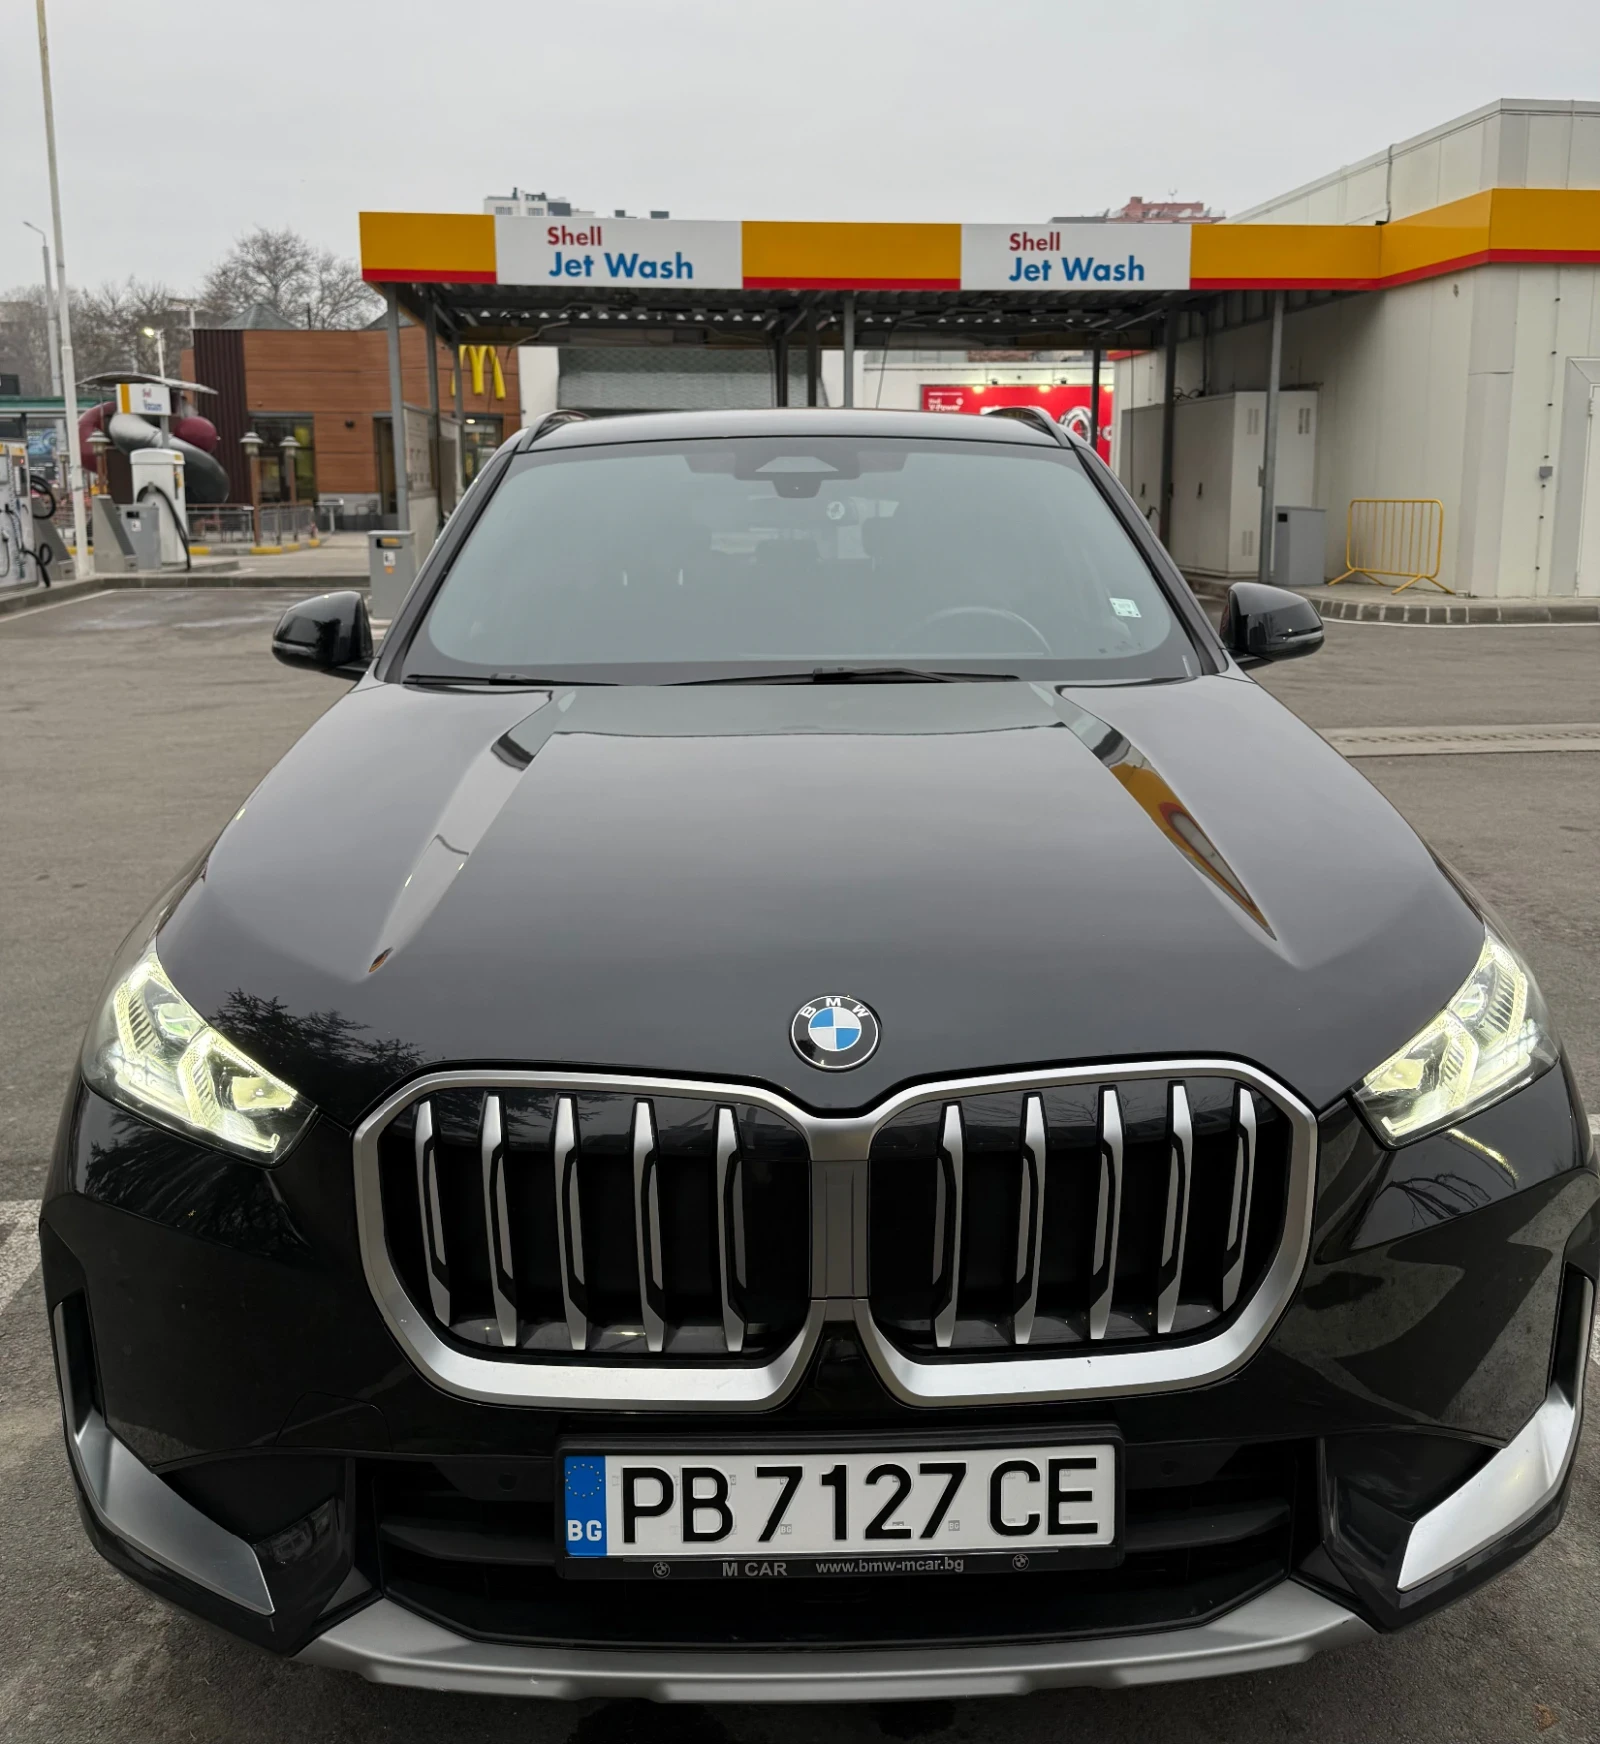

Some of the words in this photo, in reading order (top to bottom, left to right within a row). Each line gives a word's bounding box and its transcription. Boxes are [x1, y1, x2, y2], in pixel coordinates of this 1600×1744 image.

[547, 225, 602, 246] Shell
[1009, 231, 1060, 251] Shell
[549, 252, 595, 277] Jet
[604, 252, 693, 279] Wash
[1008, 256, 1052, 281] Jet
[1061, 254, 1144, 281] Wash
[799, 997, 870, 1019] BMW
[622, 1467, 734, 1544] PB
[755, 1463, 967, 1542] 7127
[990, 1458, 1099, 1537] CE
[567, 1519, 603, 1541] BG
[722, 1562, 738, 1577] M
[745, 1561, 788, 1577] CAR
[816, 1556, 964, 1574] www.bmw-mcar.bg
